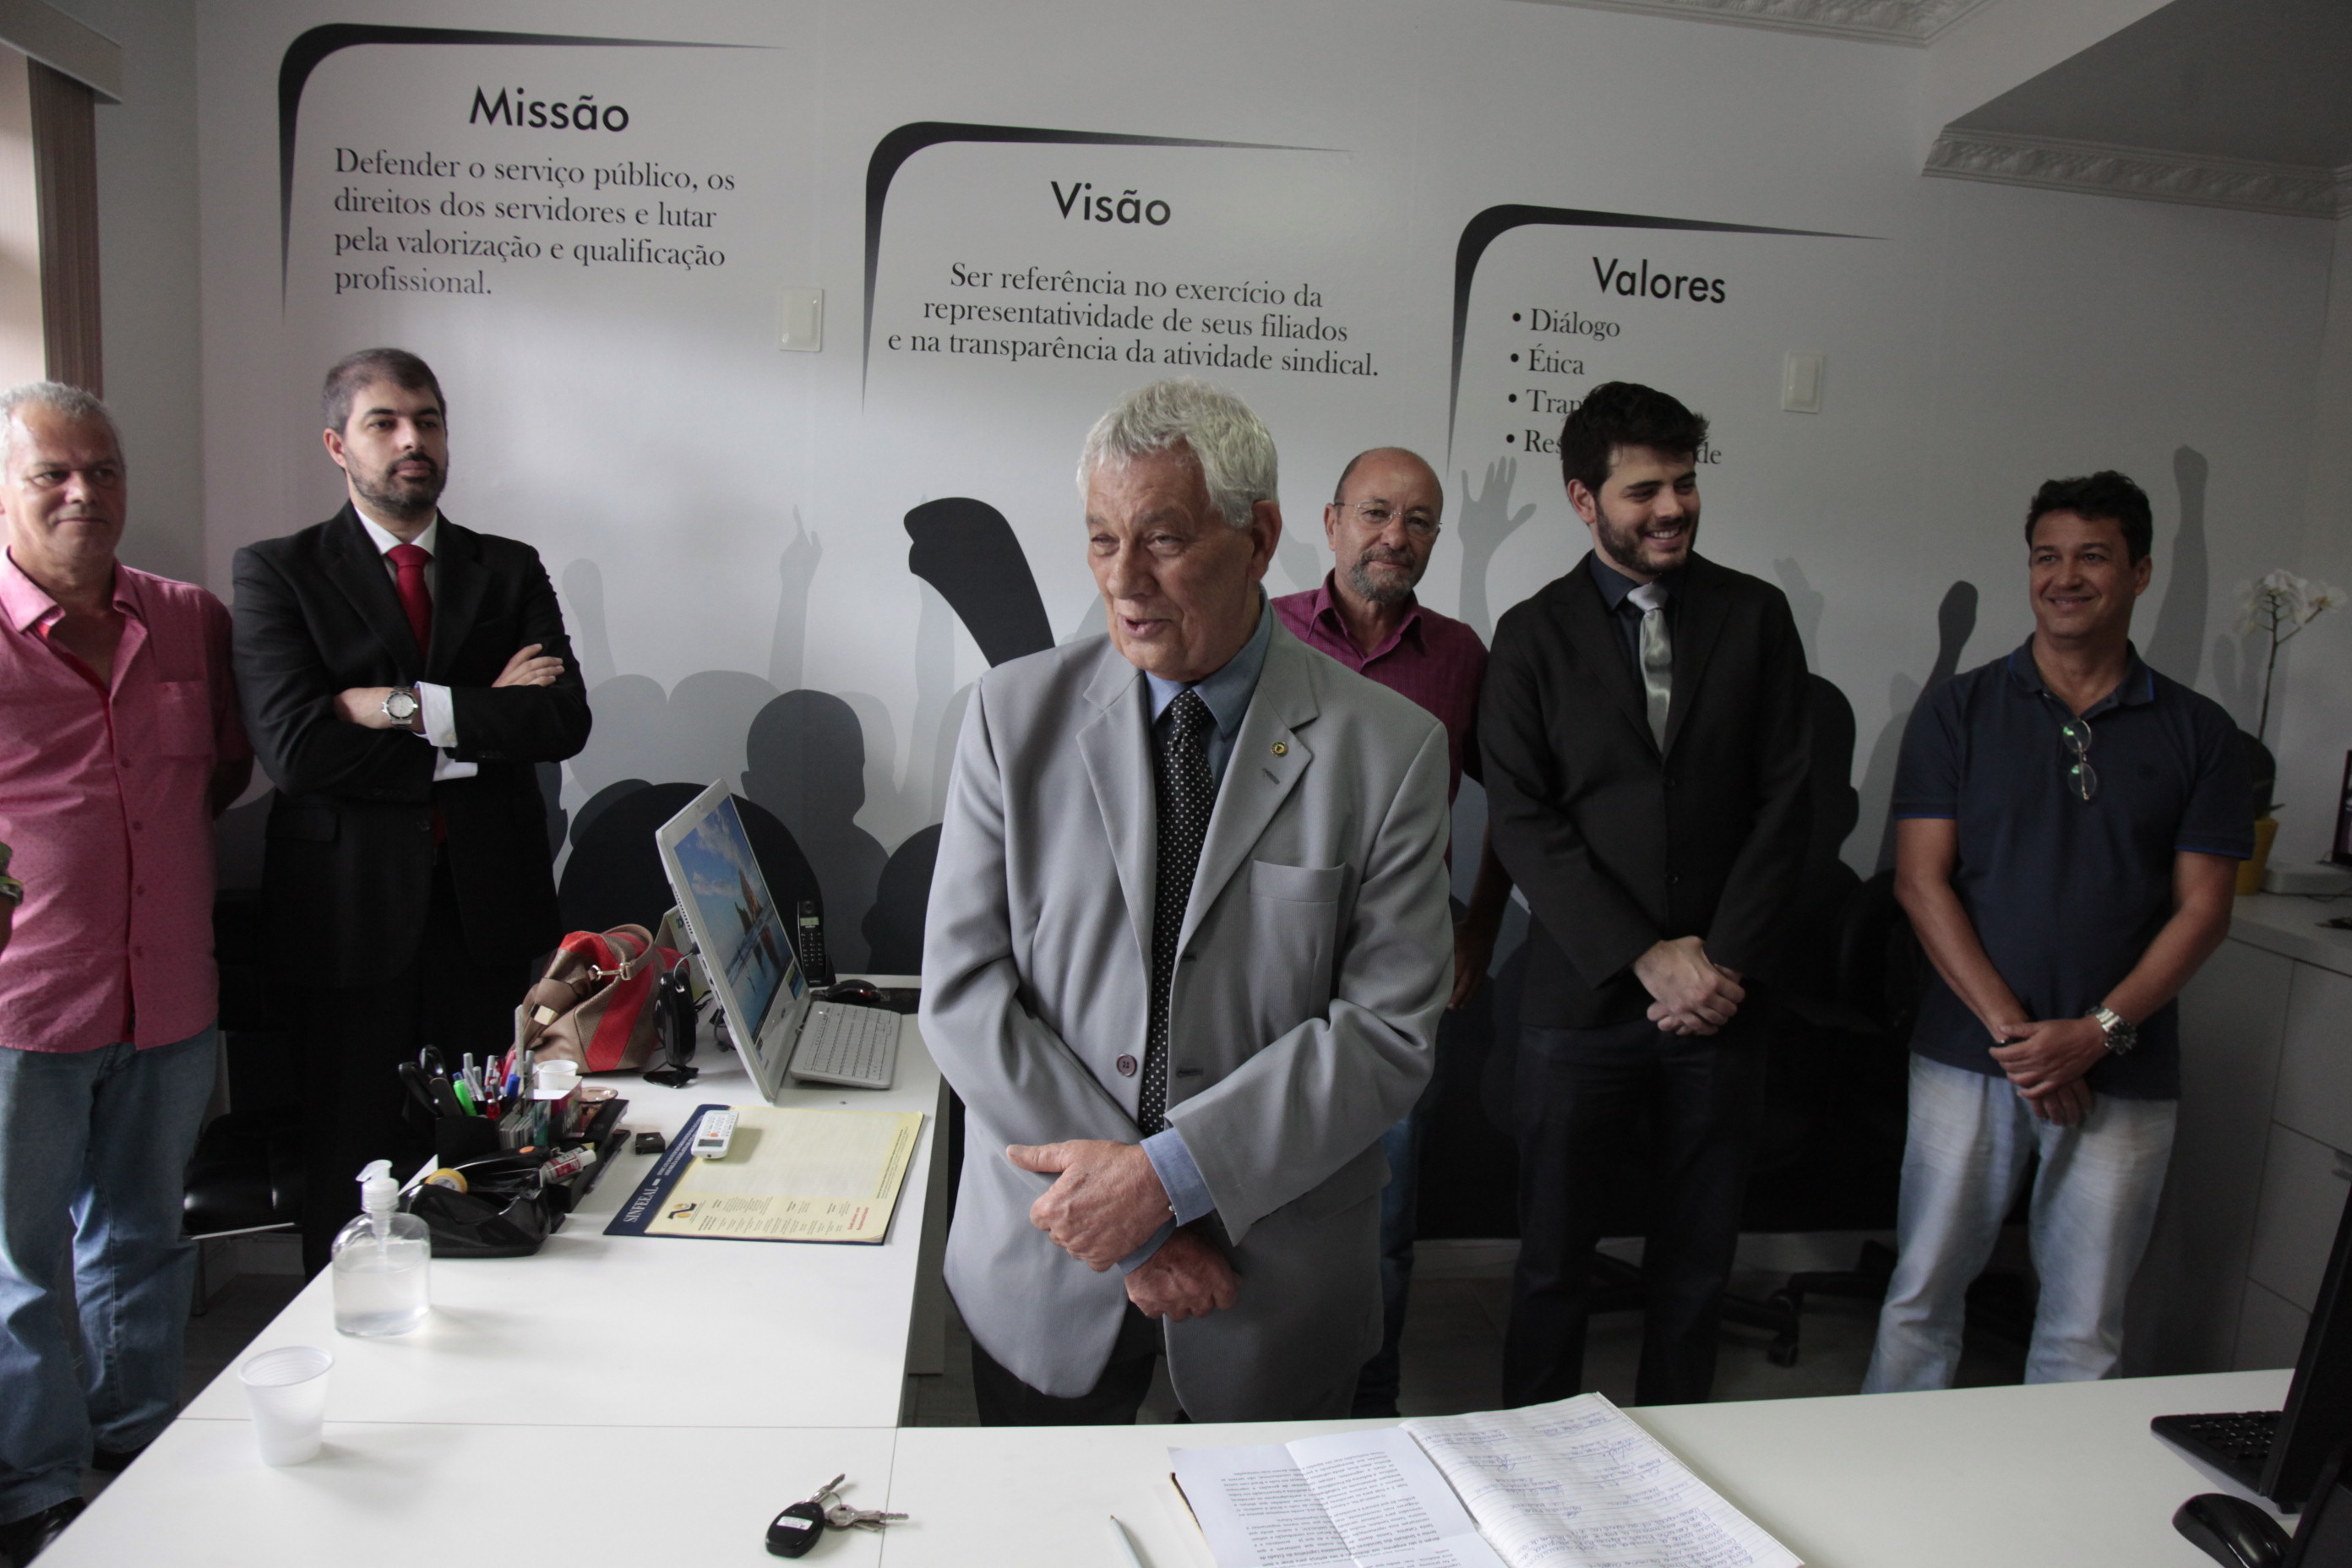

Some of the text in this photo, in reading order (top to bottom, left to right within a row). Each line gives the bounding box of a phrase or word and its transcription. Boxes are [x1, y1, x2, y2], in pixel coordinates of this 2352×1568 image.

[468, 84, 629, 133] Missão
[335, 147, 735, 192] Defender o serviço público, os
[334, 186, 717, 228] direitos dos servidores e lutar
[1050, 180, 1172, 226] Visão
[334, 226, 726, 271] pela valorização e qualificação
[334, 265, 492, 295] profissional.
[950, 262, 1323, 308] Ser referência no exercício da
[1592, 256, 1726, 304] Valores
[923, 301, 1348, 342] representatividade de seus filiados
[1530, 308, 1621, 342] Diálogo
[888, 334, 1379, 377] e na transparência da atividade sindical.
[1527, 343, 1585, 376] Ética
